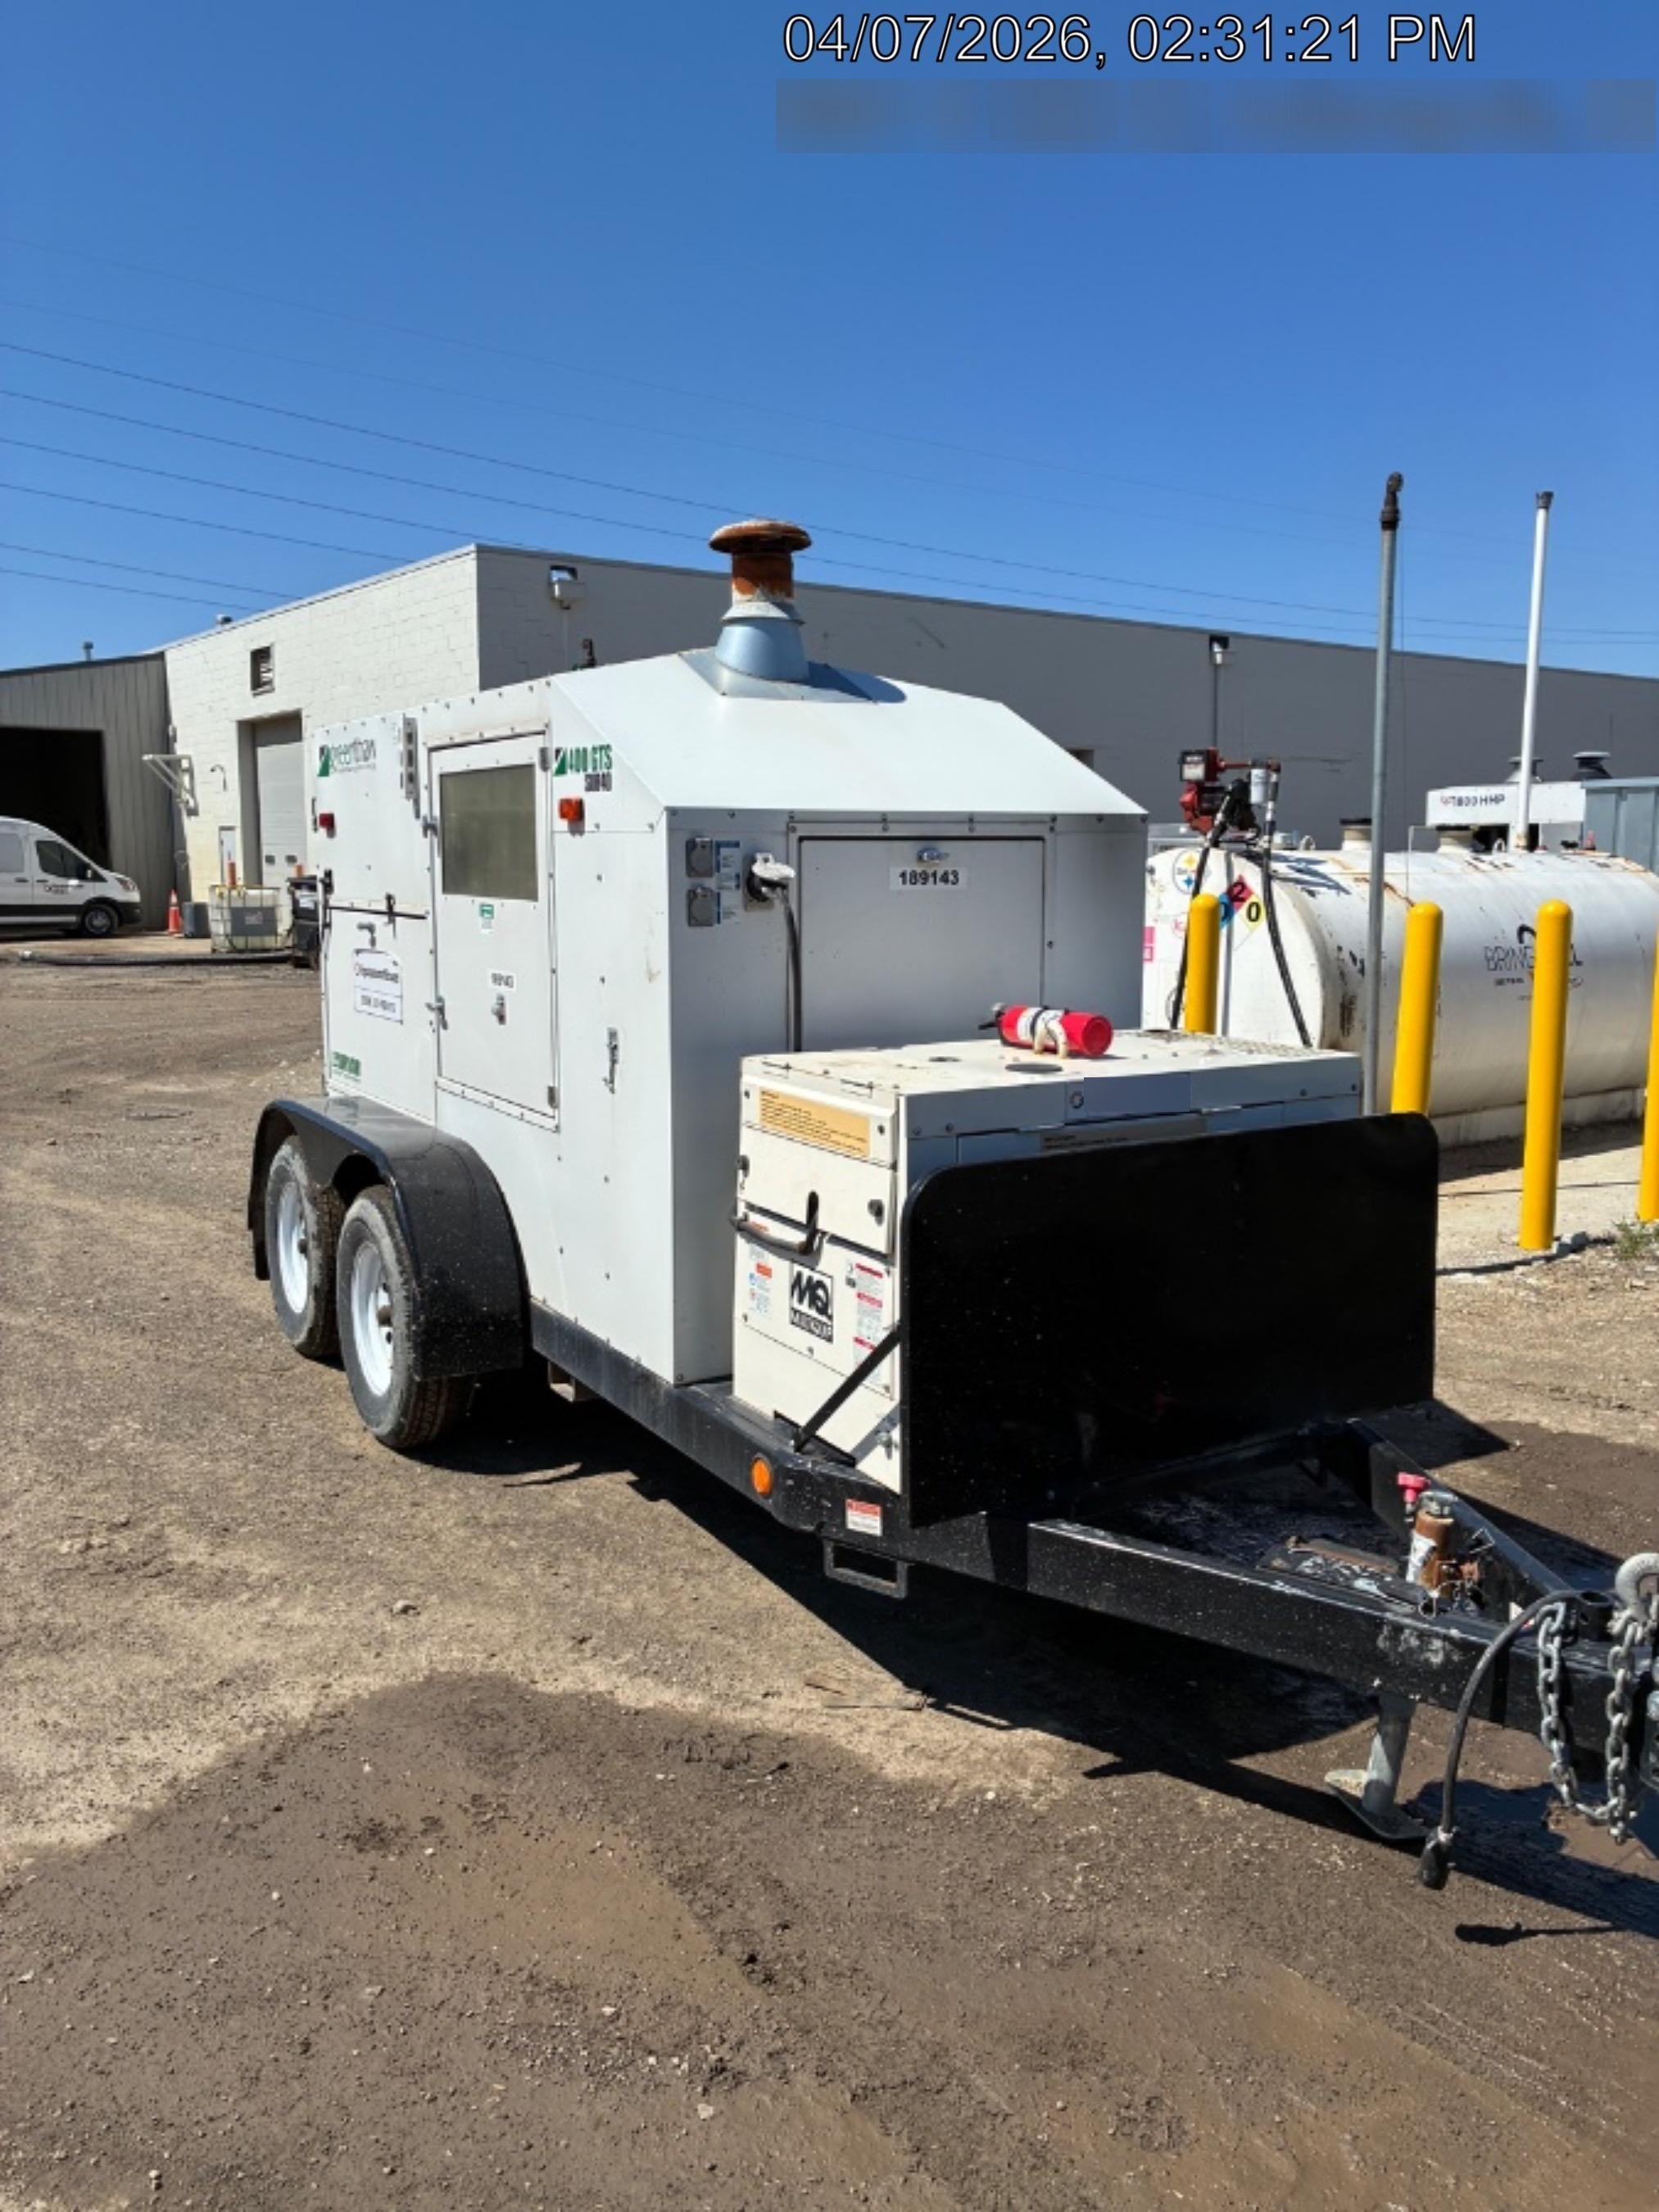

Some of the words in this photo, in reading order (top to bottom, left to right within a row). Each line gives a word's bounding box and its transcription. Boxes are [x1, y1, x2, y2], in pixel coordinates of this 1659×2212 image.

[900, 870, 959, 885] 189143
[1229, 882, 1246, 903] 2
[1246, 902, 1261, 922] 0
